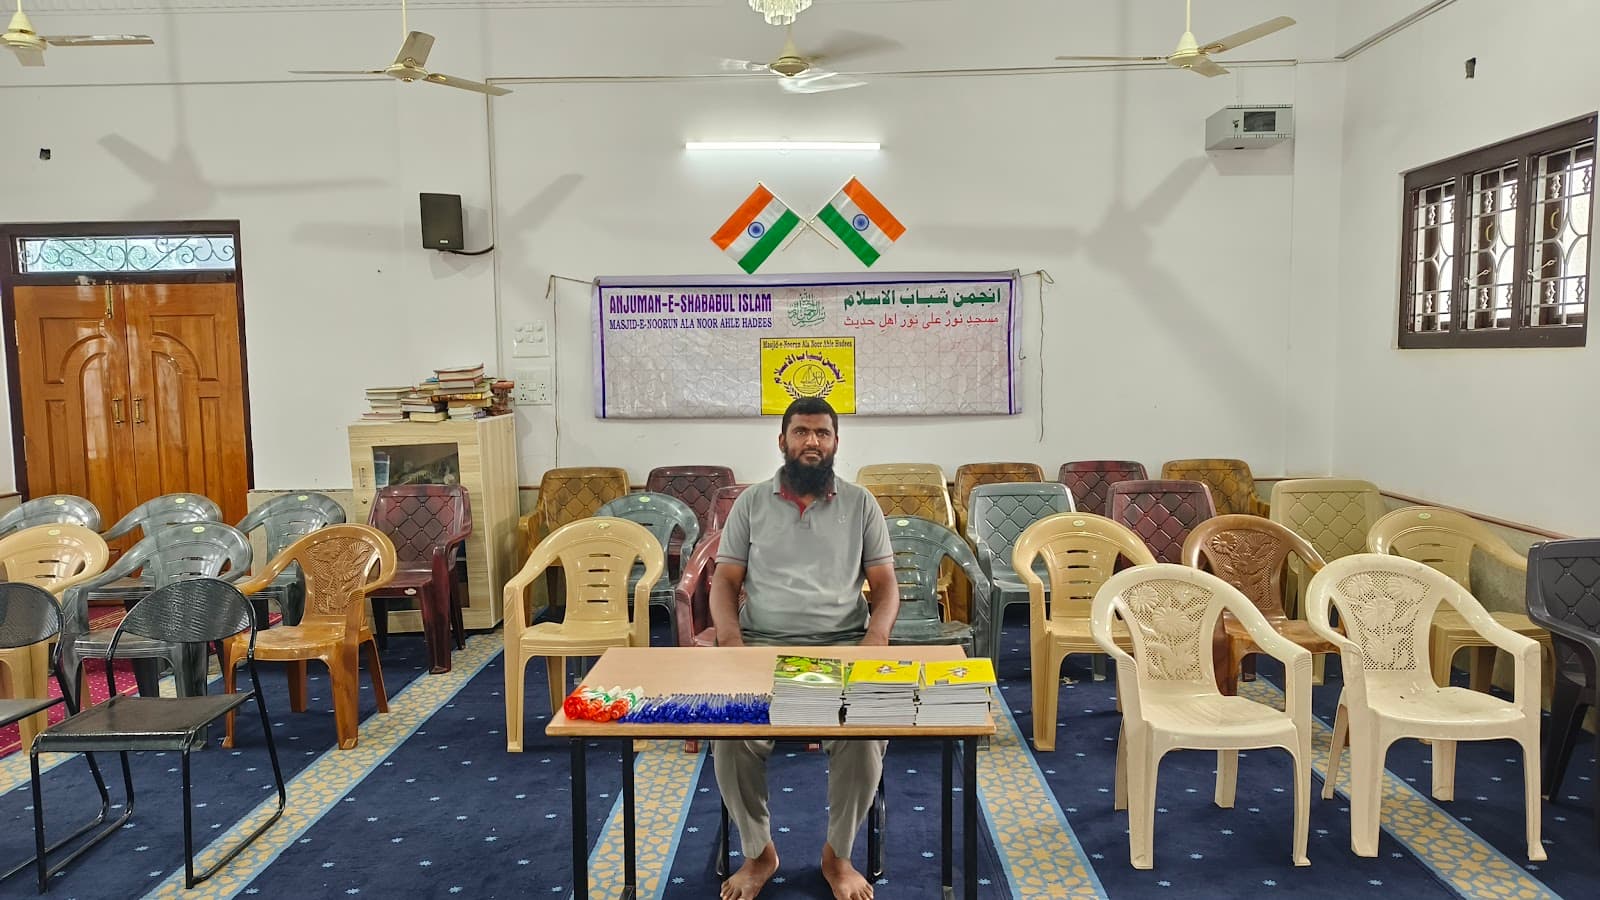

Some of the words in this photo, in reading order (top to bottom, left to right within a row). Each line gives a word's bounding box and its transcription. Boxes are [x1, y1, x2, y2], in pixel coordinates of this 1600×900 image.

[609, 294, 735, 314] ANJUMAN-E-SHABABUL
[738, 293, 772, 313] ISLAM
[844, 289, 895, 310] الاسلام
[953, 288, 1001, 307] انجمن
[609, 318, 678, 330] MASJID-E-NOORUN
[680, 318, 695, 329] ALA
[697, 318, 718, 328] NOOR
[720, 317, 740, 328] AHLE
[742, 317, 773, 328] HADEES
